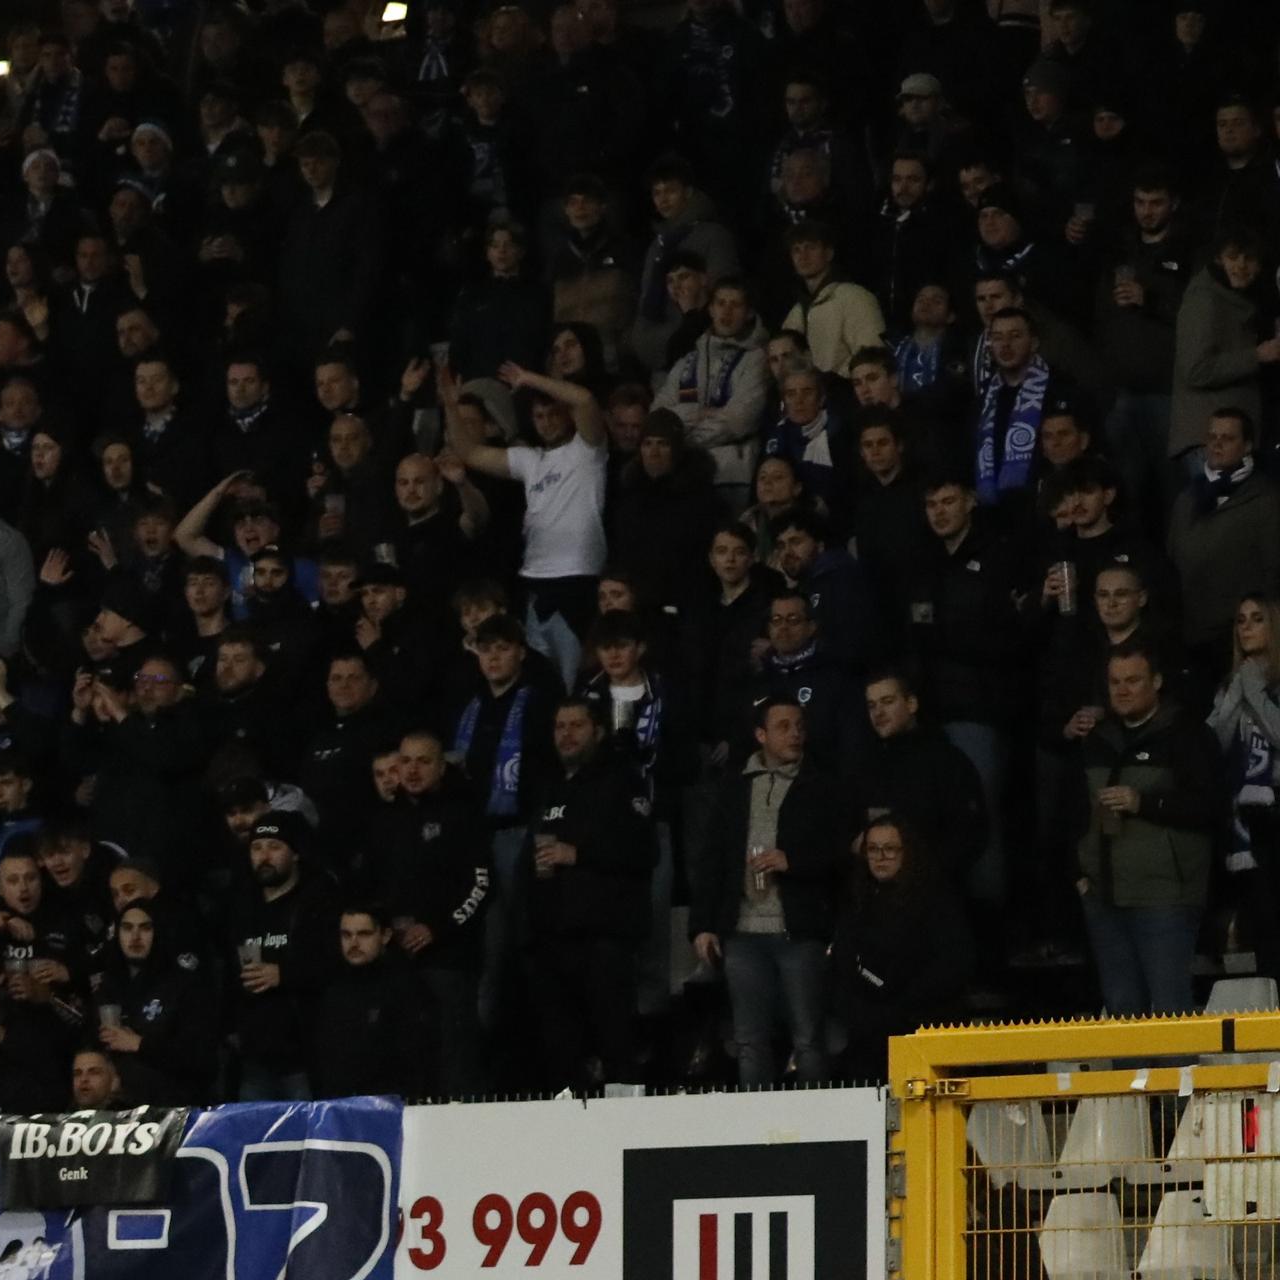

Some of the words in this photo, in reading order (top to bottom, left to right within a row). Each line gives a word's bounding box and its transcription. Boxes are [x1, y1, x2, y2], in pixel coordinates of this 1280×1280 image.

[9, 1121, 161, 1160] IB.BOYS
[59, 1166, 89, 1181] Genk
[397, 1195, 447, 1271] 3
[472, 1190, 603, 1268] 999
